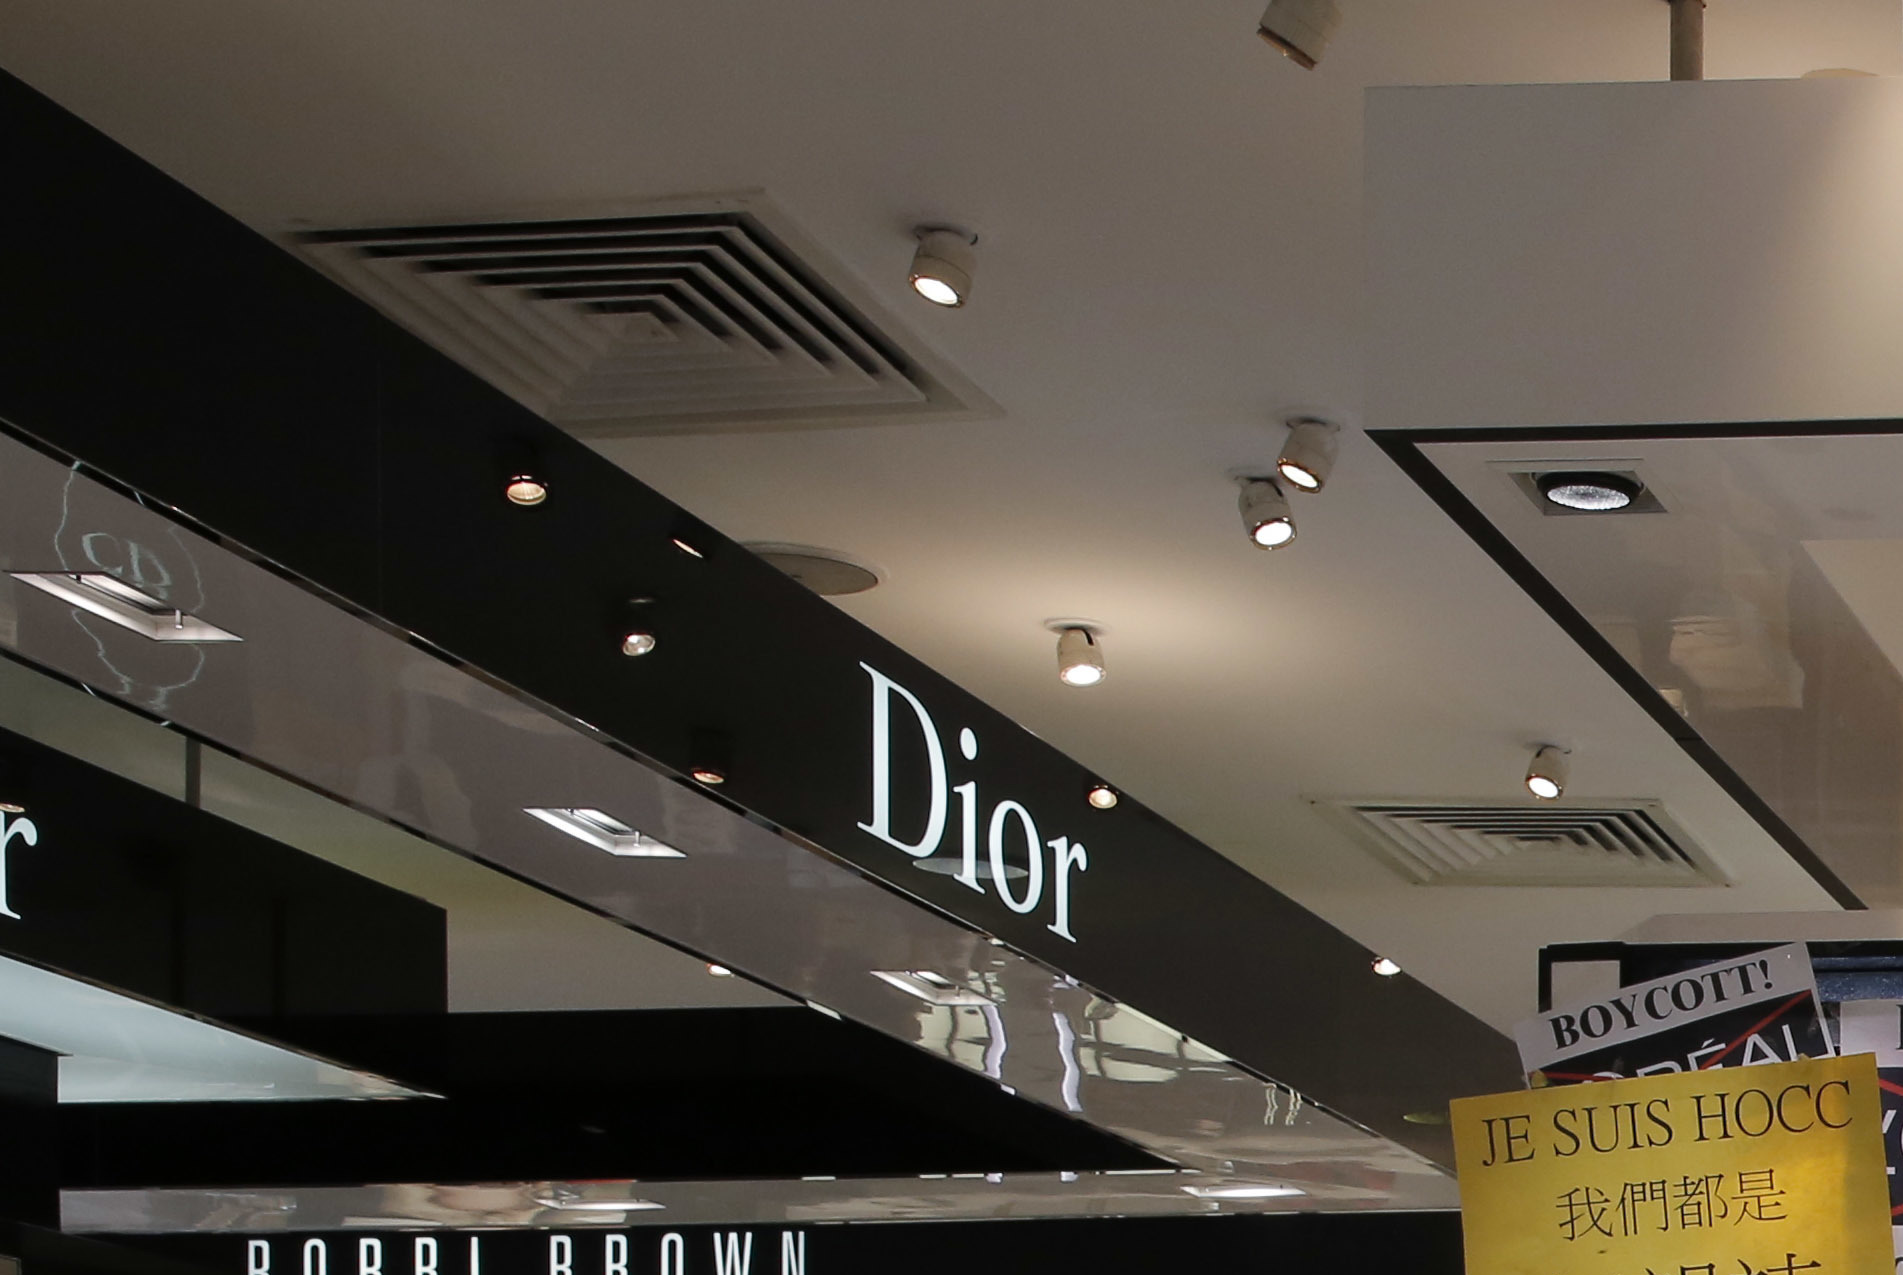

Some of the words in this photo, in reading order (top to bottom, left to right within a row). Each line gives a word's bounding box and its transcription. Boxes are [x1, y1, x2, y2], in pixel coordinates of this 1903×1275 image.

[861, 661, 1089, 942] Dior
[1548, 959, 1775, 1050] BOYCOTT!
[1481, 1114, 1536, 1167] JE
[1553, 1098, 1675, 1158] SUIS
[1690, 1080, 1854, 1143] HOCC
[1556, 1168, 1788, 1242] 我們都是
